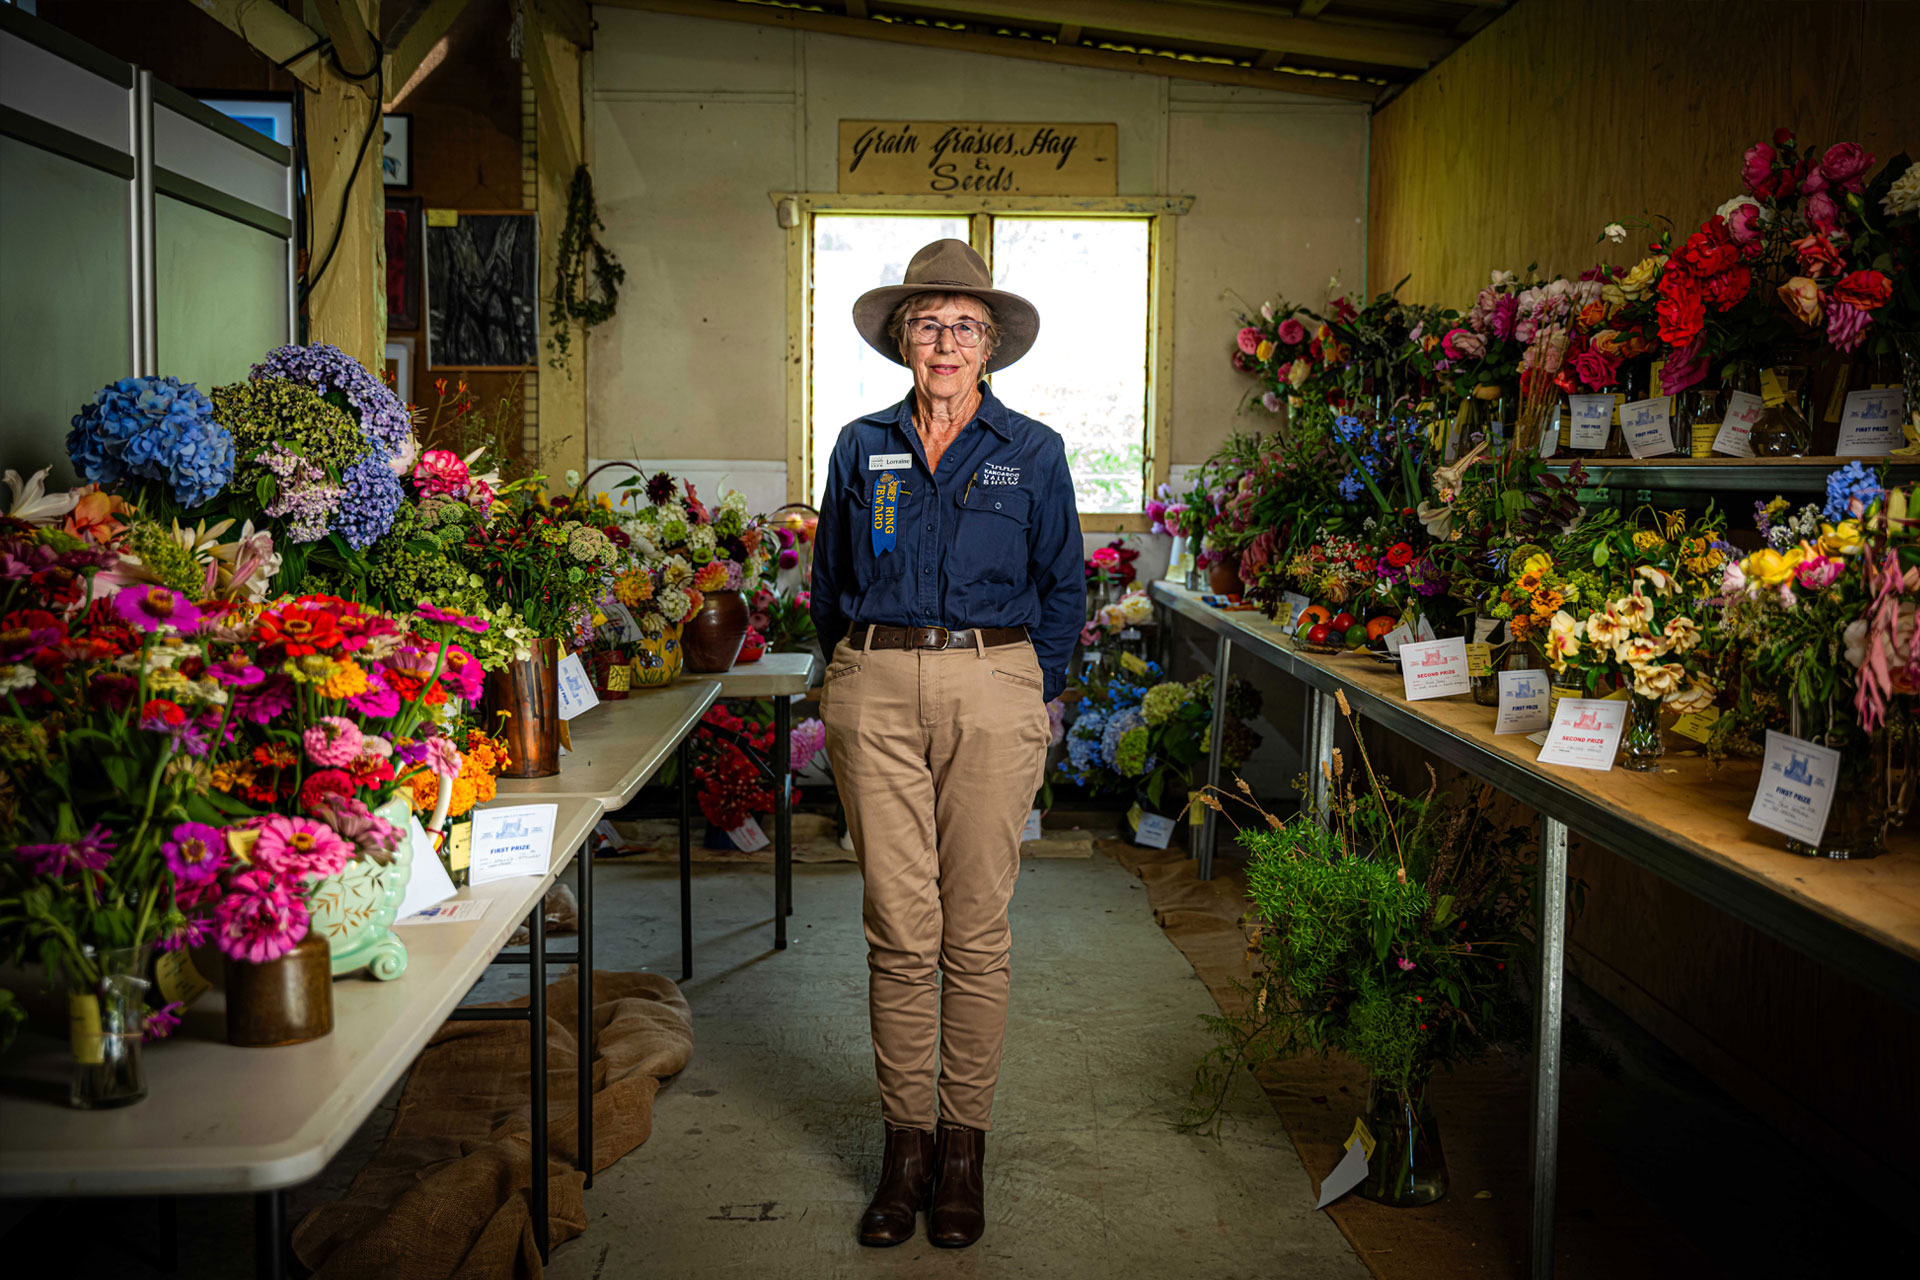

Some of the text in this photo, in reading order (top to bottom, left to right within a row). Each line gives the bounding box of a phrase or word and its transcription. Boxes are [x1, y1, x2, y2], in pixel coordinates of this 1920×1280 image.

[849, 125, 920, 172] Grain
[1020, 127, 1077, 171] Hay
[974, 157, 991, 171] &
[984, 468, 1020, 478] KANGAROO
[984, 473, 1019, 482] VALLEY
[885, 506, 895, 534] RING
[1417, 669, 1456, 679] SECOND PRIZE
[1562, 735, 1586, 743] SECOND
[1775, 786, 1811, 805] FIRST PRIZE
[490, 844, 530, 854] FIRST PRIZE
